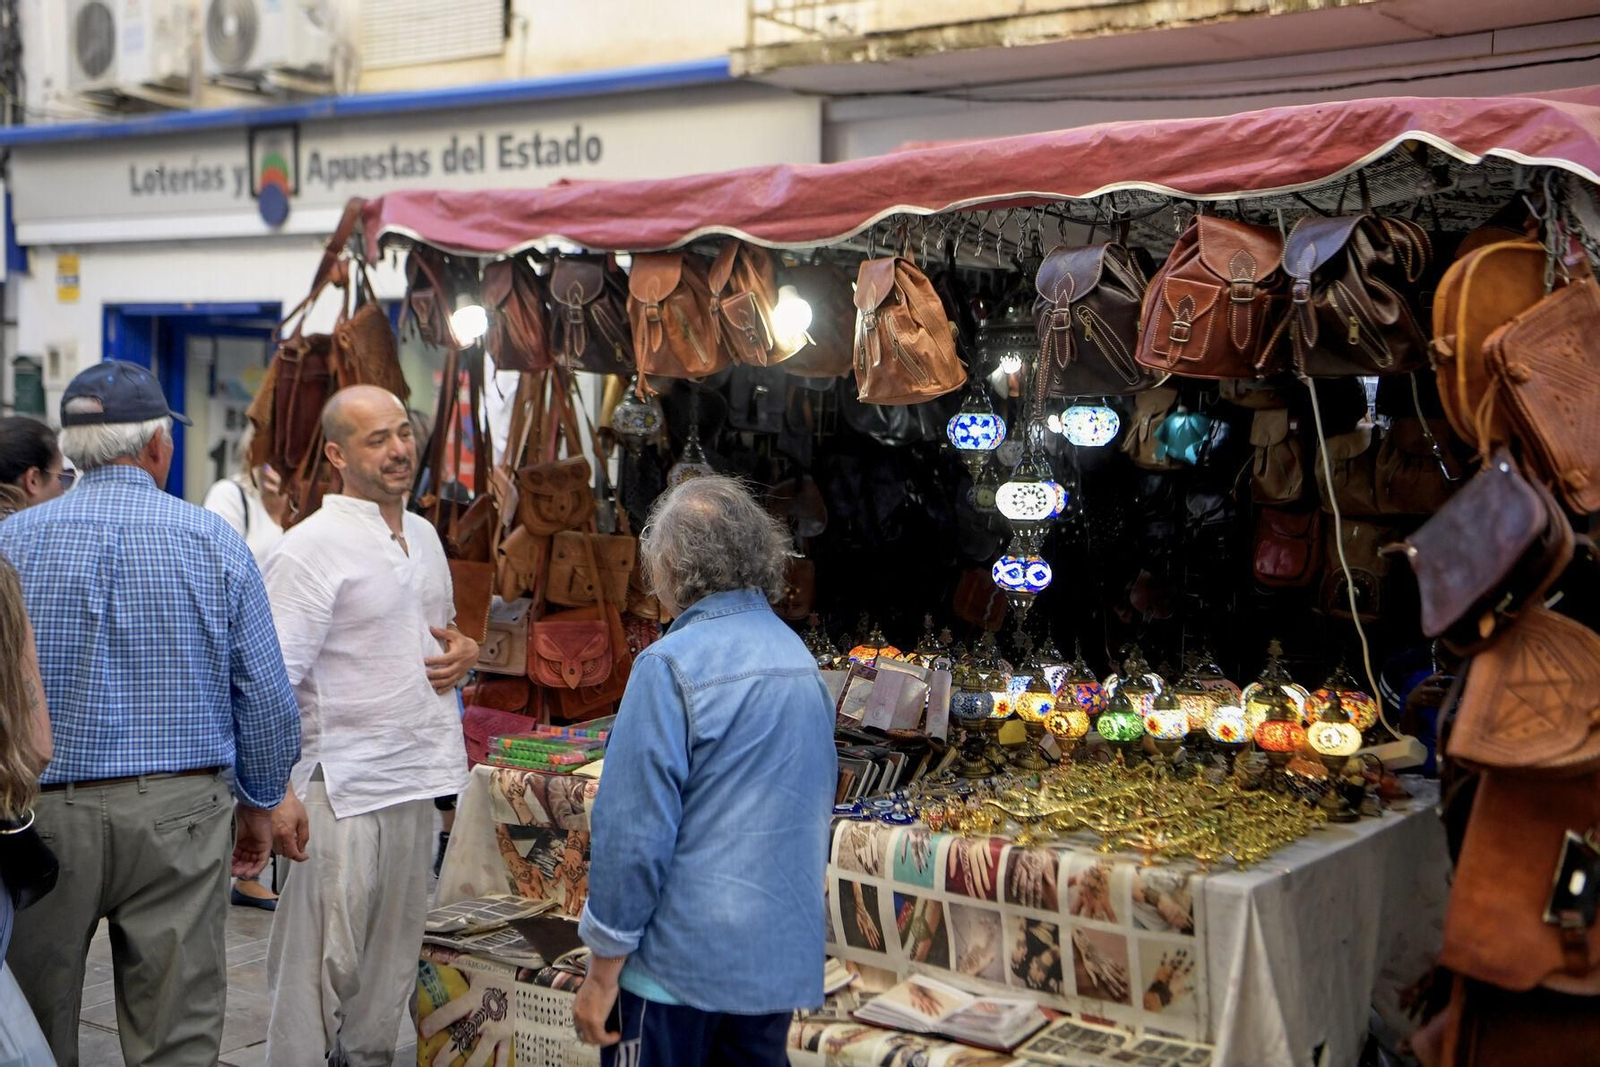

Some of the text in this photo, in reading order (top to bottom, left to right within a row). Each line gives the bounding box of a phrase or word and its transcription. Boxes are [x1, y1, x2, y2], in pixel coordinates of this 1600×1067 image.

[129, 125, 604, 199] Loterías y Apuestas del Estado
